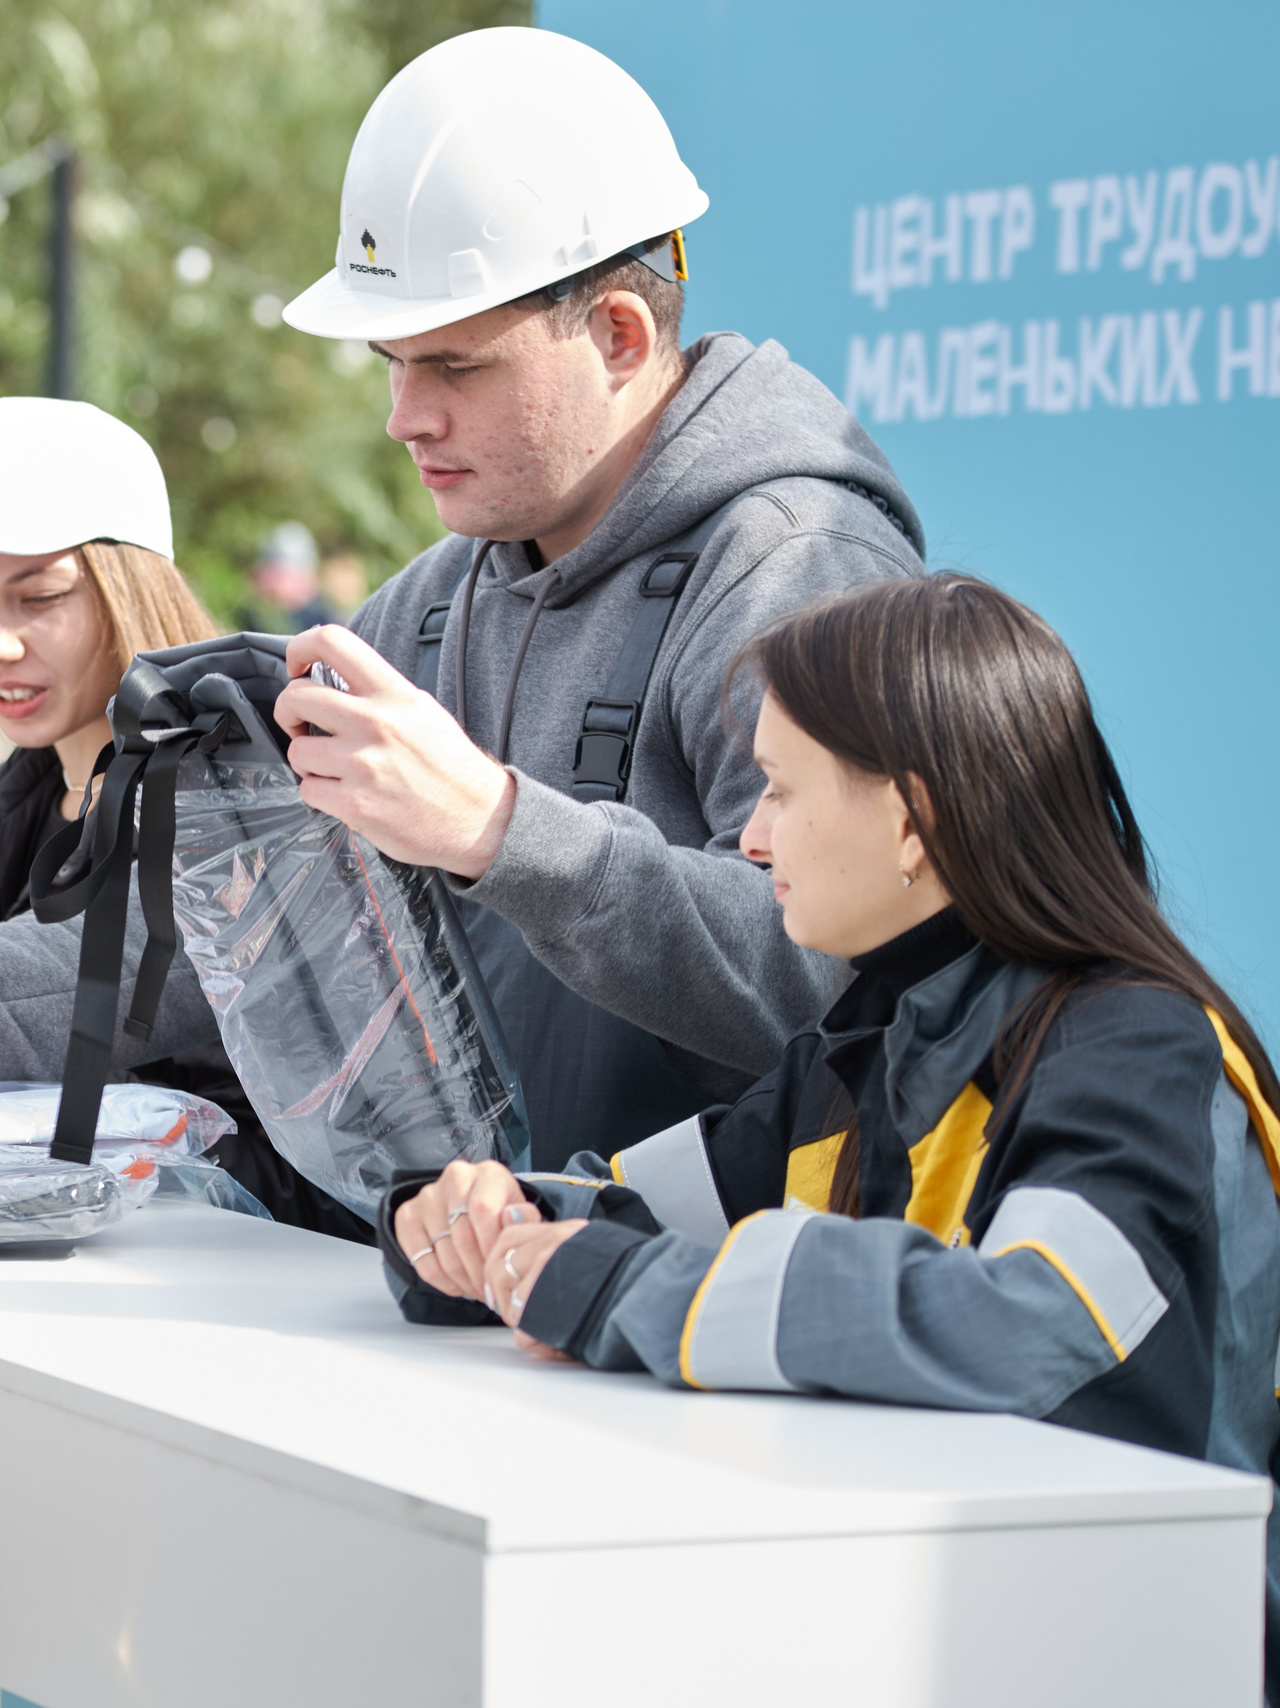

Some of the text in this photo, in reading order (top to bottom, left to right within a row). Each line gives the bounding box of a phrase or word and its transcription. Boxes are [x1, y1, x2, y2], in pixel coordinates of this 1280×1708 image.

[349, 263, 397, 278] РОСНЕФТЬ
[852, 155, 1280, 309] ЦЕНТР ТРУДОУ
[847, 298, 1280, 423] МАЛЕНЬКИХ Н
